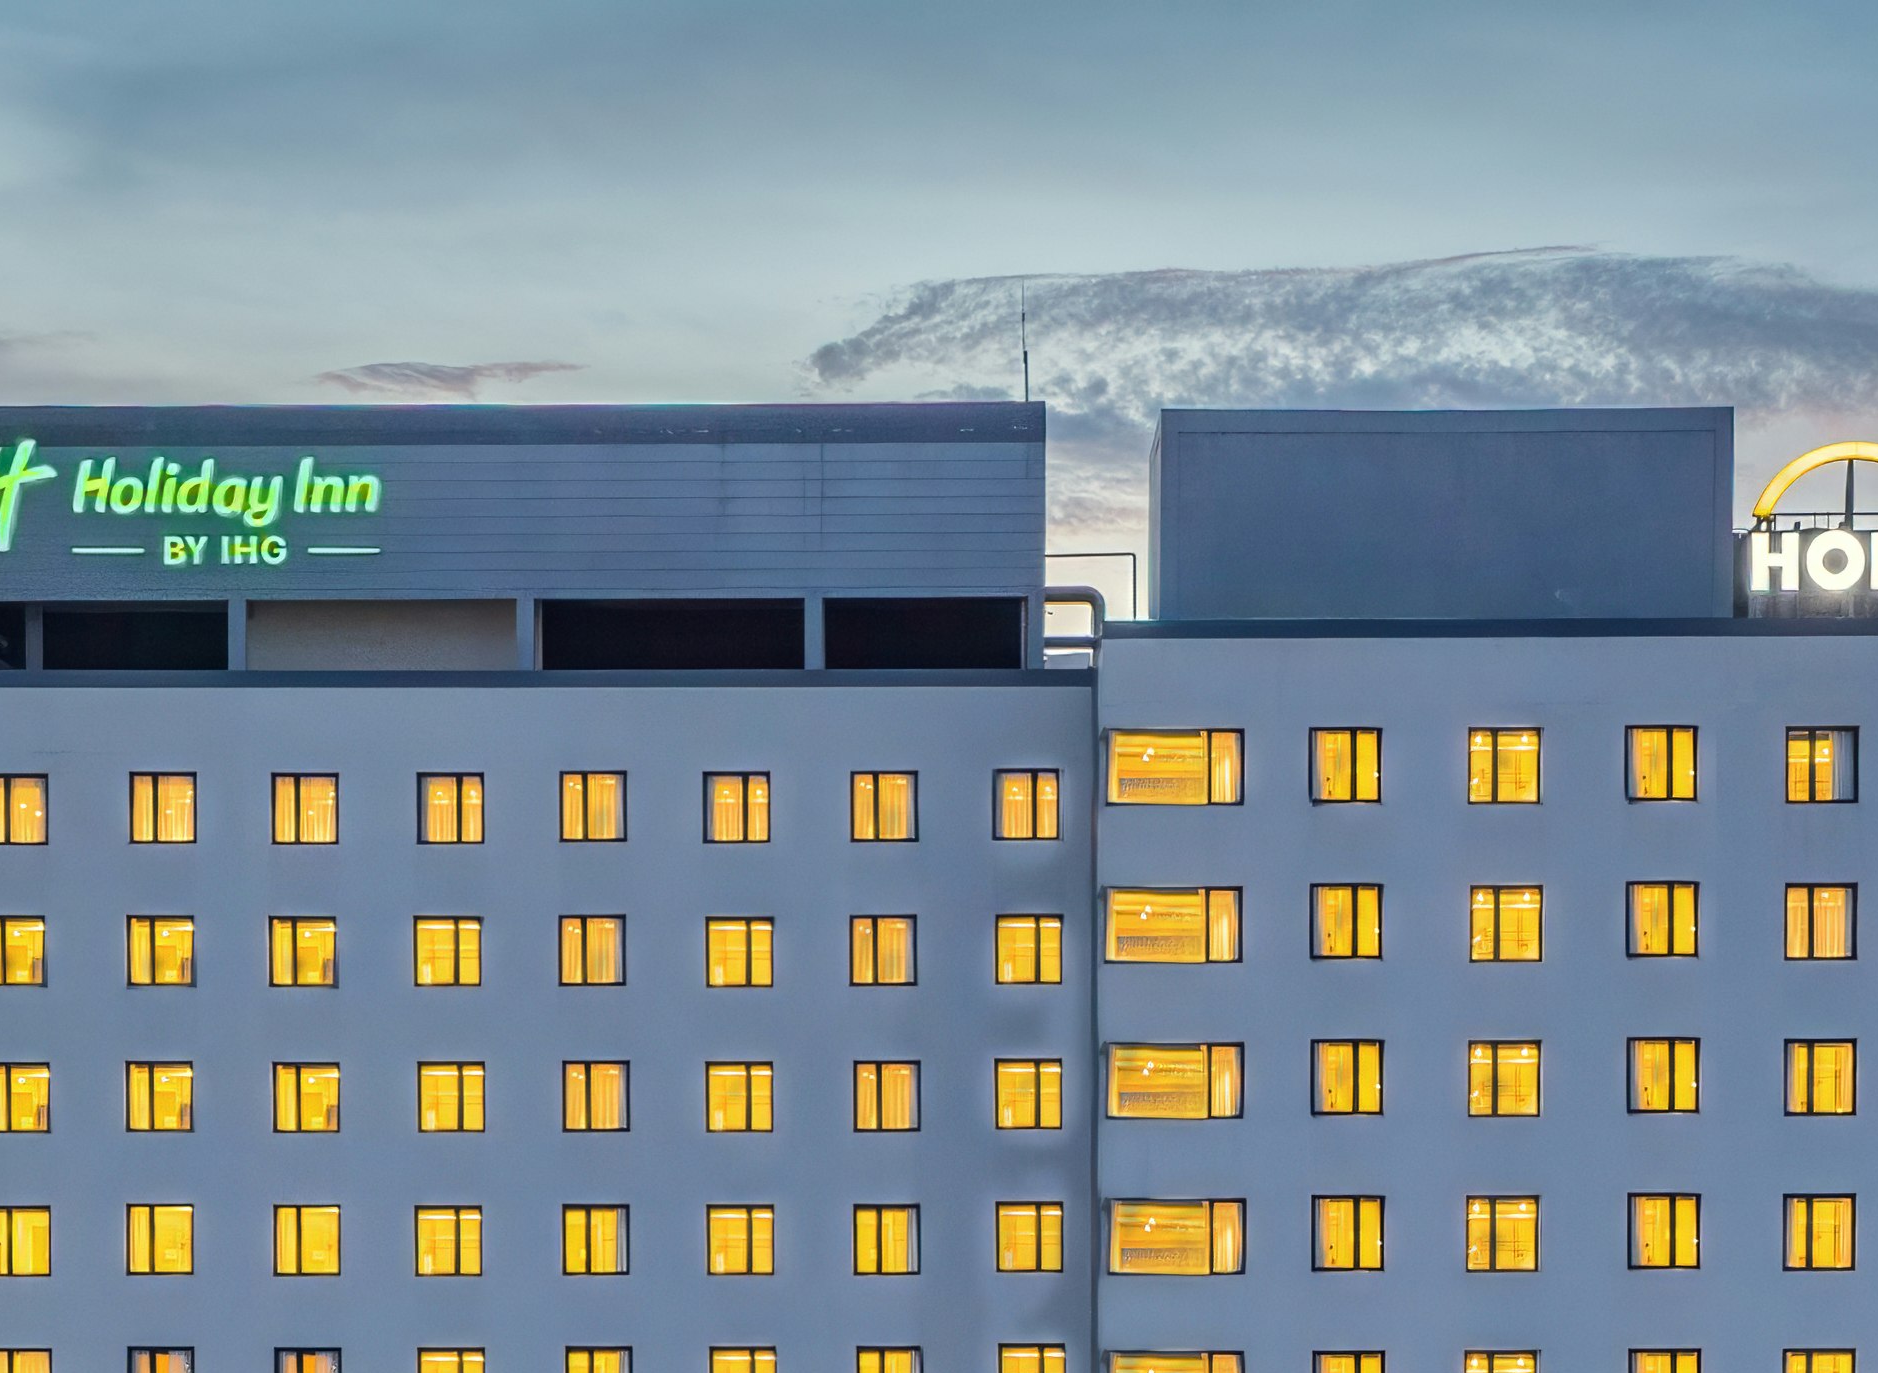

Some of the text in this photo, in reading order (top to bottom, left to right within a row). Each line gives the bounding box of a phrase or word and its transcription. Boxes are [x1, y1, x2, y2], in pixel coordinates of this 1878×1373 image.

[72, 456, 382, 527] Holiday Inn
[163, 535, 288, 566] BY IHG
